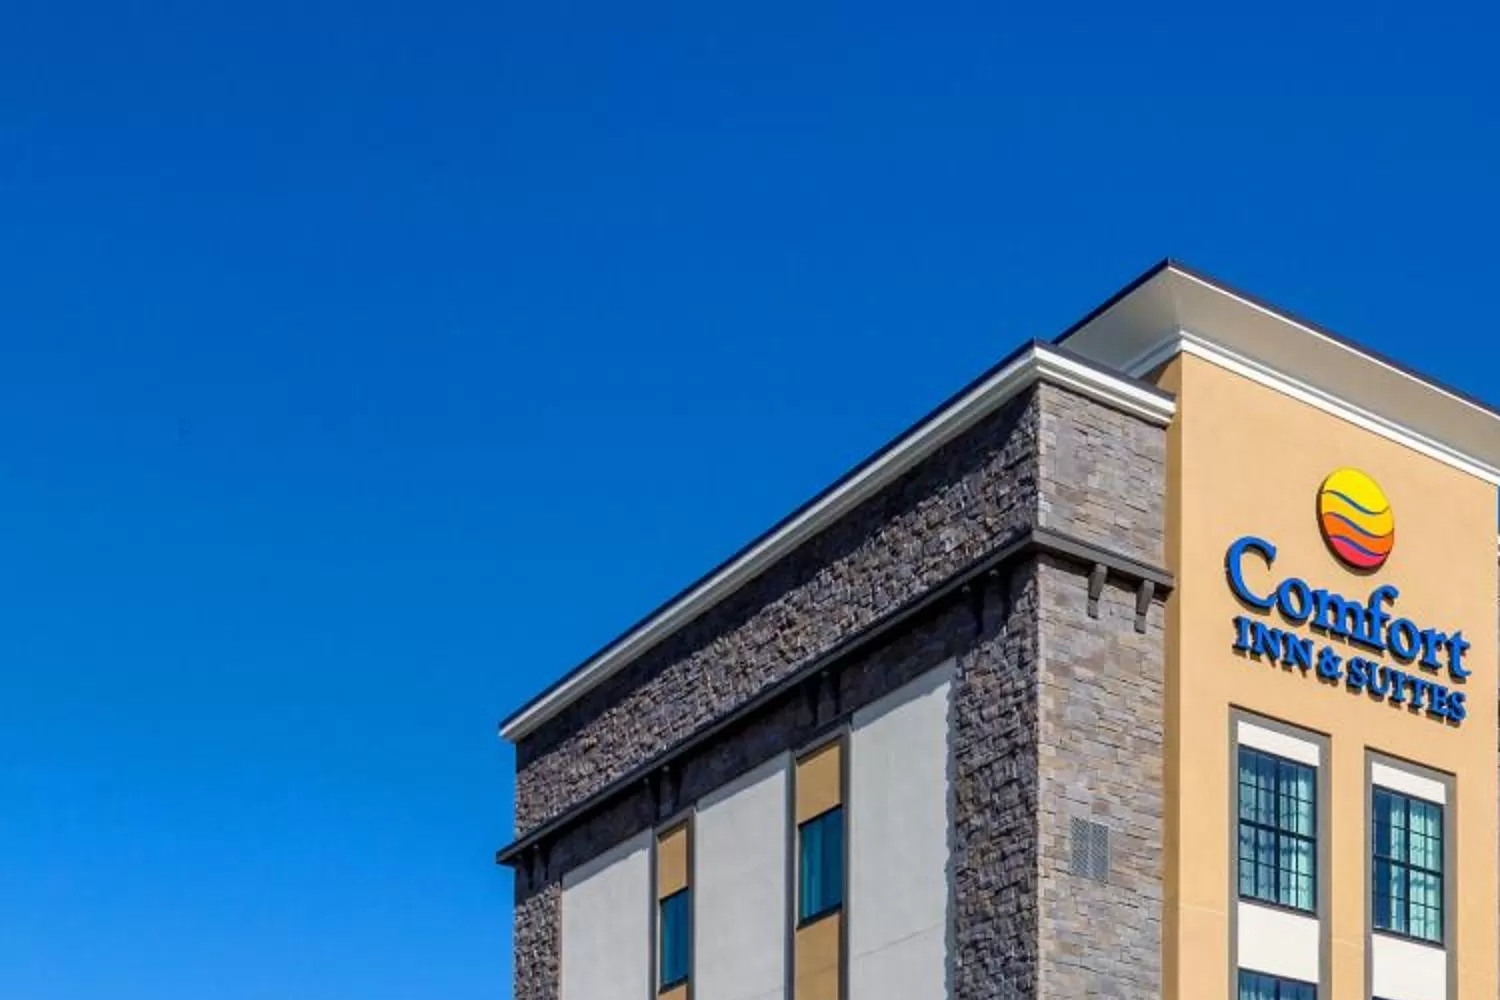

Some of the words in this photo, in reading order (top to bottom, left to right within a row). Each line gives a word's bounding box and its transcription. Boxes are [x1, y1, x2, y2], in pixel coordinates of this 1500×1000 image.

[1225, 535, 1472, 681] Comfort
[1232, 615, 1314, 671] INN
[1316, 645, 1343, 679] &
[1346, 655, 1467, 722] SUITES
